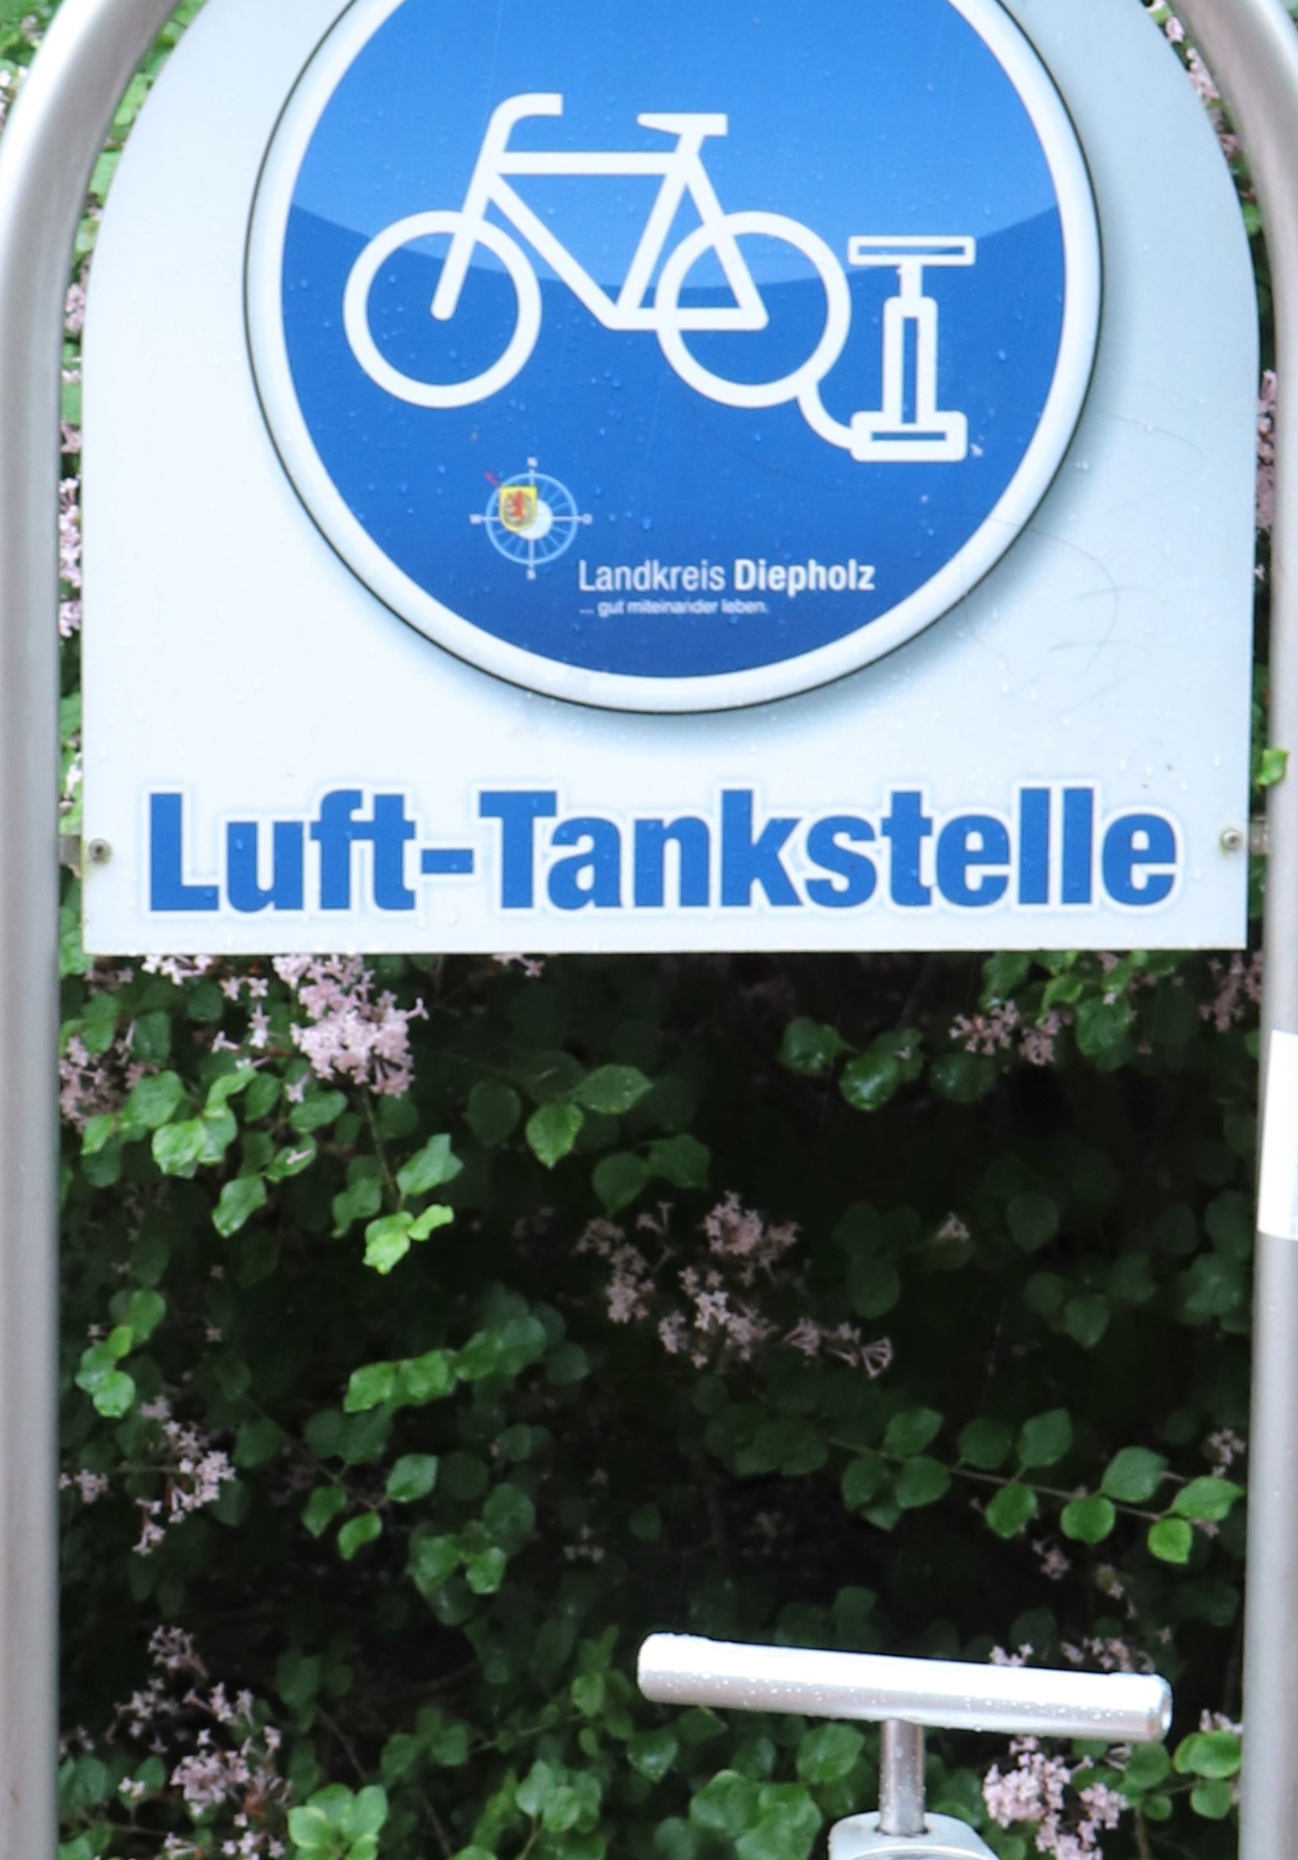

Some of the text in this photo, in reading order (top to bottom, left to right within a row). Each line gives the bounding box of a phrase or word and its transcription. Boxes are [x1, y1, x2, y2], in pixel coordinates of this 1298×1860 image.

[578, 558, 876, 598] Landkreis Diepholz
[596, 599, 624, 618] gut
[627, 598, 718, 614] miteinander
[721, 598, 769, 614] leben.
[148, 787, 1177, 912] Luft-Tankstelle
